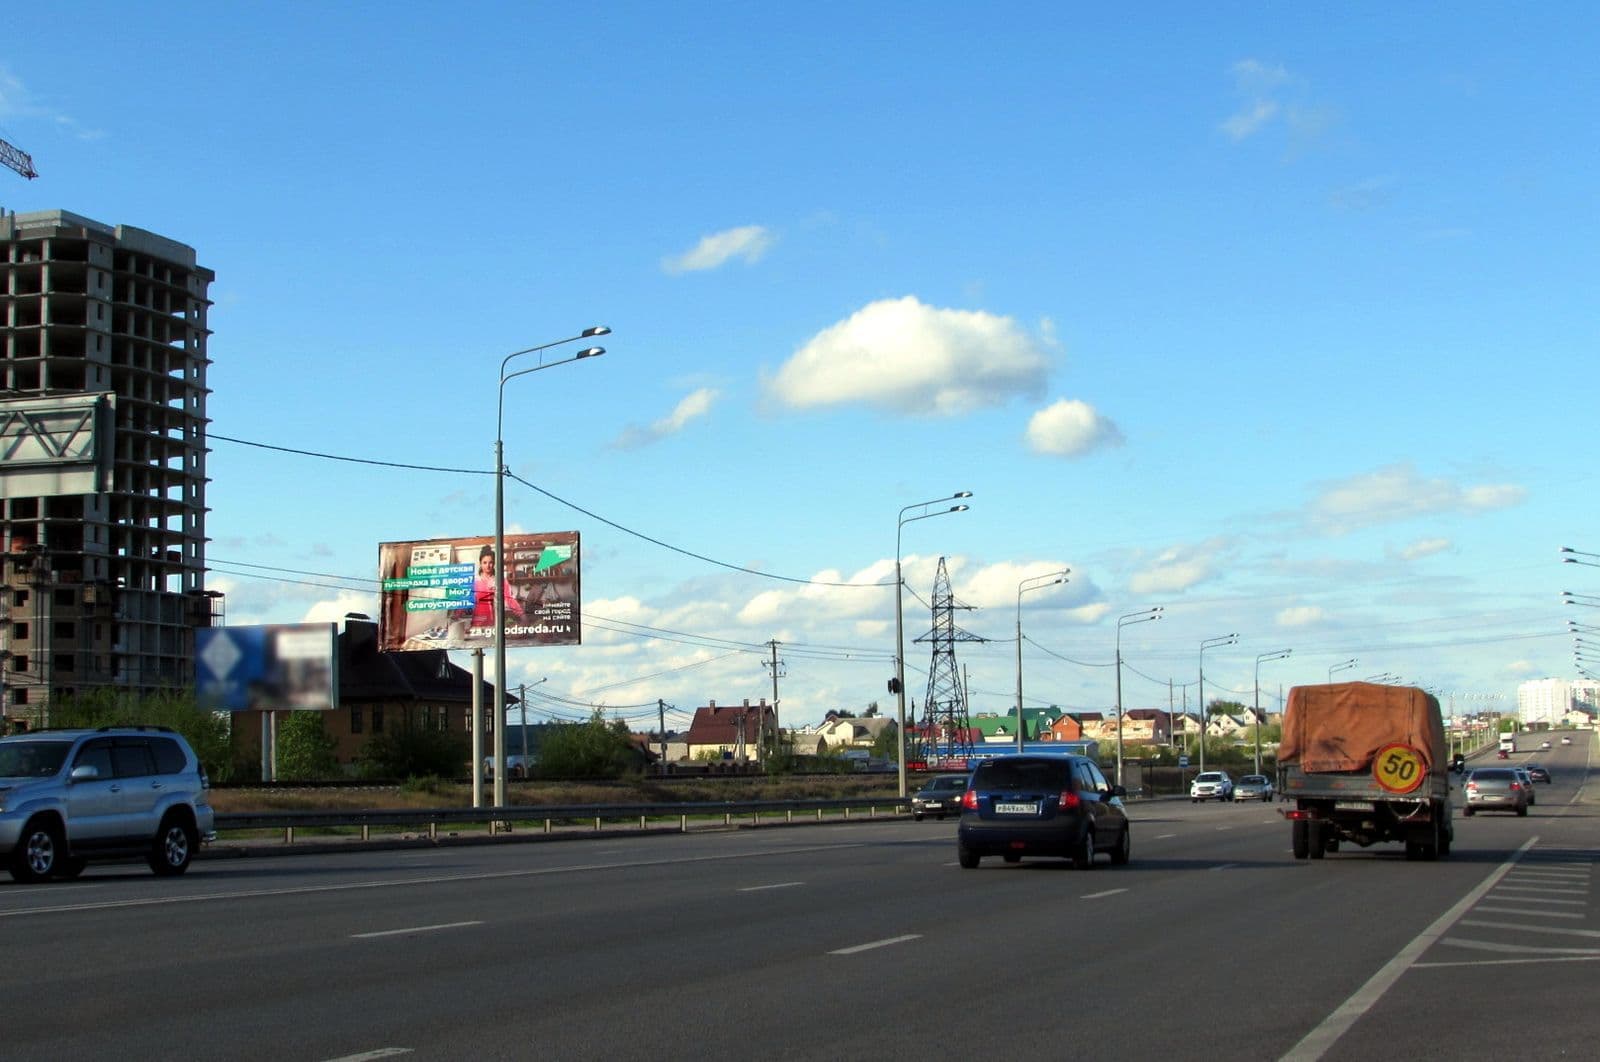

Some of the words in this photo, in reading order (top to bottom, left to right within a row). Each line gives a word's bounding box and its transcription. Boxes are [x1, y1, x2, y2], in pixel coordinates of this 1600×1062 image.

[410, 567, 437, 576] Новая
[438, 565, 474, 574] детская
[384, 578, 429, 588] площадка
[442, 576, 474, 586] дворе?
[449, 588, 472, 597] Могу
[469, 623, 564, 638] za.goodsreda.ru
[1383, 753, 1415, 780] 50
